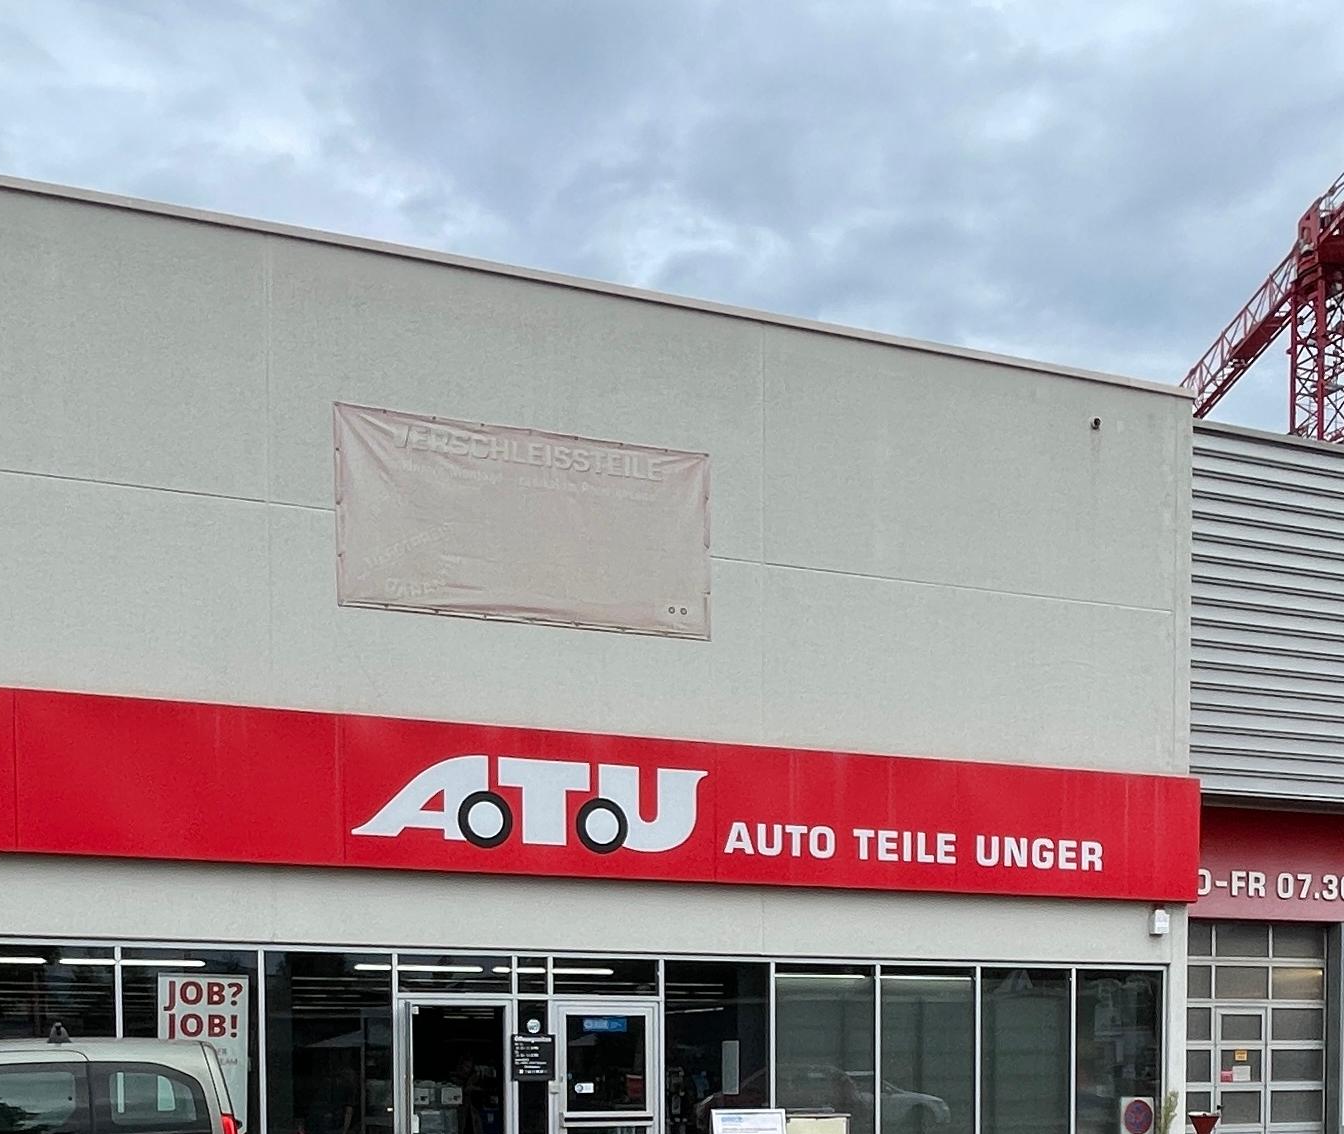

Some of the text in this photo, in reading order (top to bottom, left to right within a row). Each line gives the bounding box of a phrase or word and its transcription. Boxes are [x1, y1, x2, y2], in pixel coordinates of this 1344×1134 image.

[351, 755, 709, 854] ATU
[724, 822, 1104, 872] AUTO TEILE UNGER
[1197, 868, 1267, 897] O-FR
[163, 980, 244, 1011] JOB?
[168, 1012, 239, 1039] JOB!
